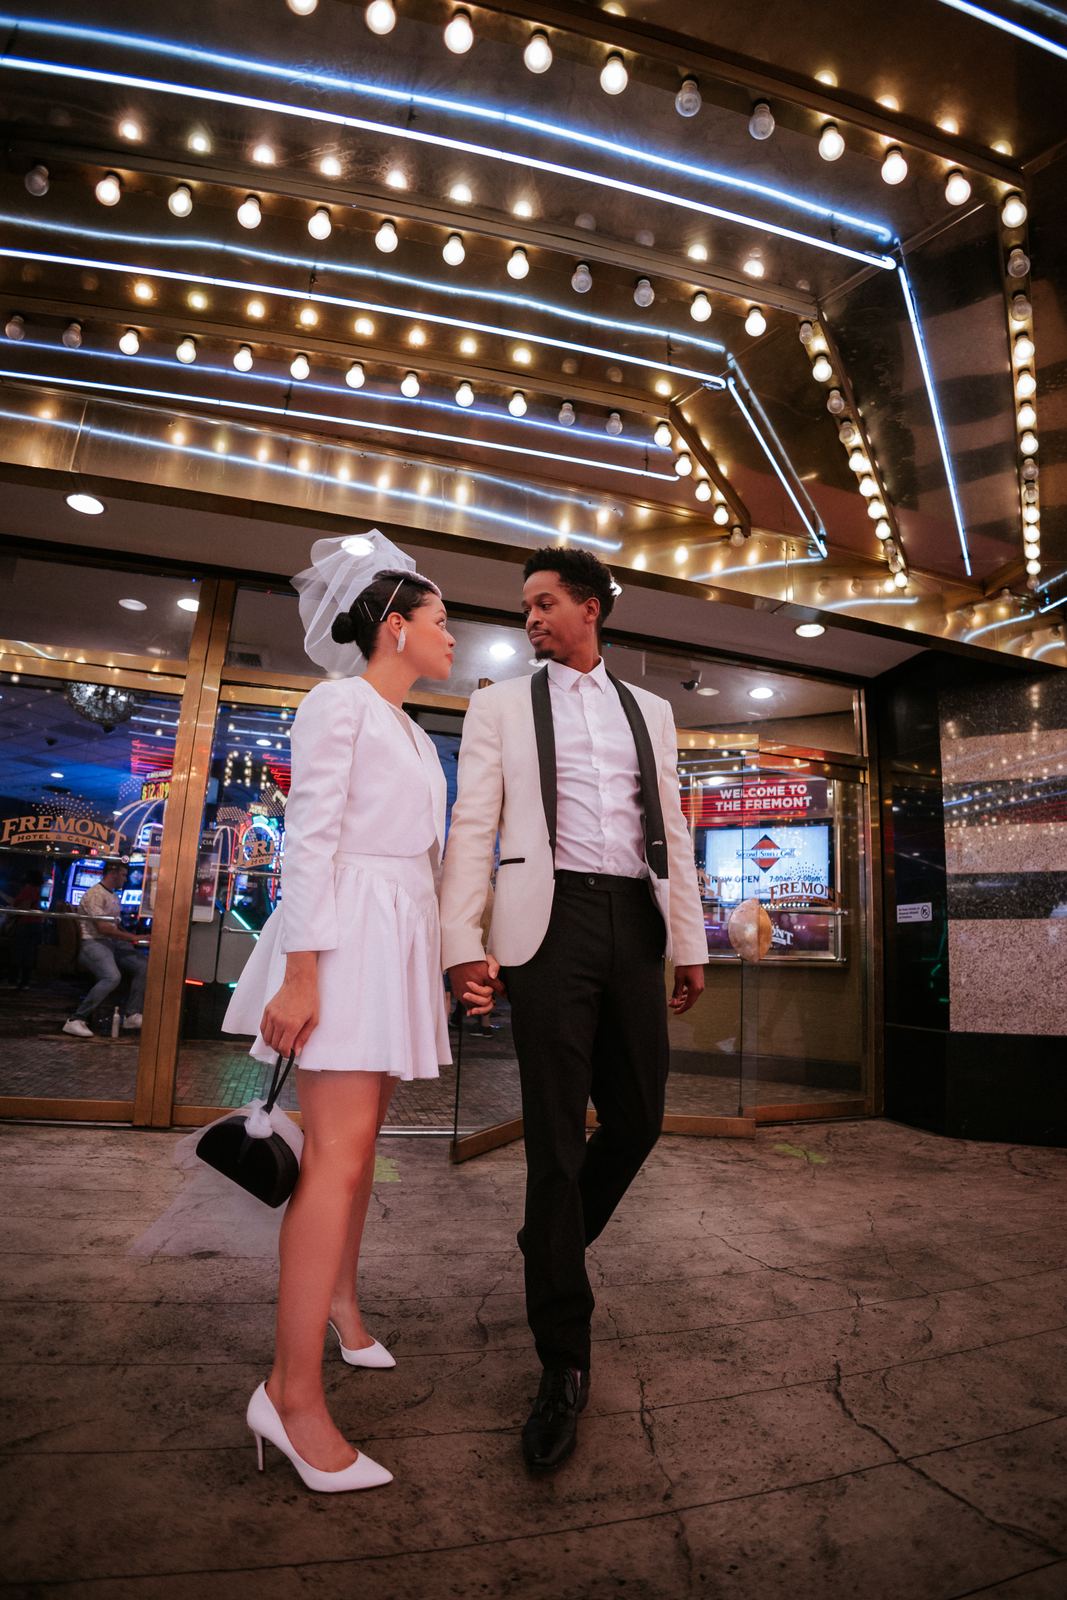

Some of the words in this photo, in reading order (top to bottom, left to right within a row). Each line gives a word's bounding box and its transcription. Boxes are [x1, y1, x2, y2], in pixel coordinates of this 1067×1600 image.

[720, 786, 785, 799] WELCOME
[789, 784, 807, 795] TO
[715, 800, 741, 812] THE
[745, 796, 812, 810] FREMONT
[0, 815, 127, 856] FREMONT
[17, 833, 49, 841] HOTEL
[735, 875, 760, 883] OPEN
